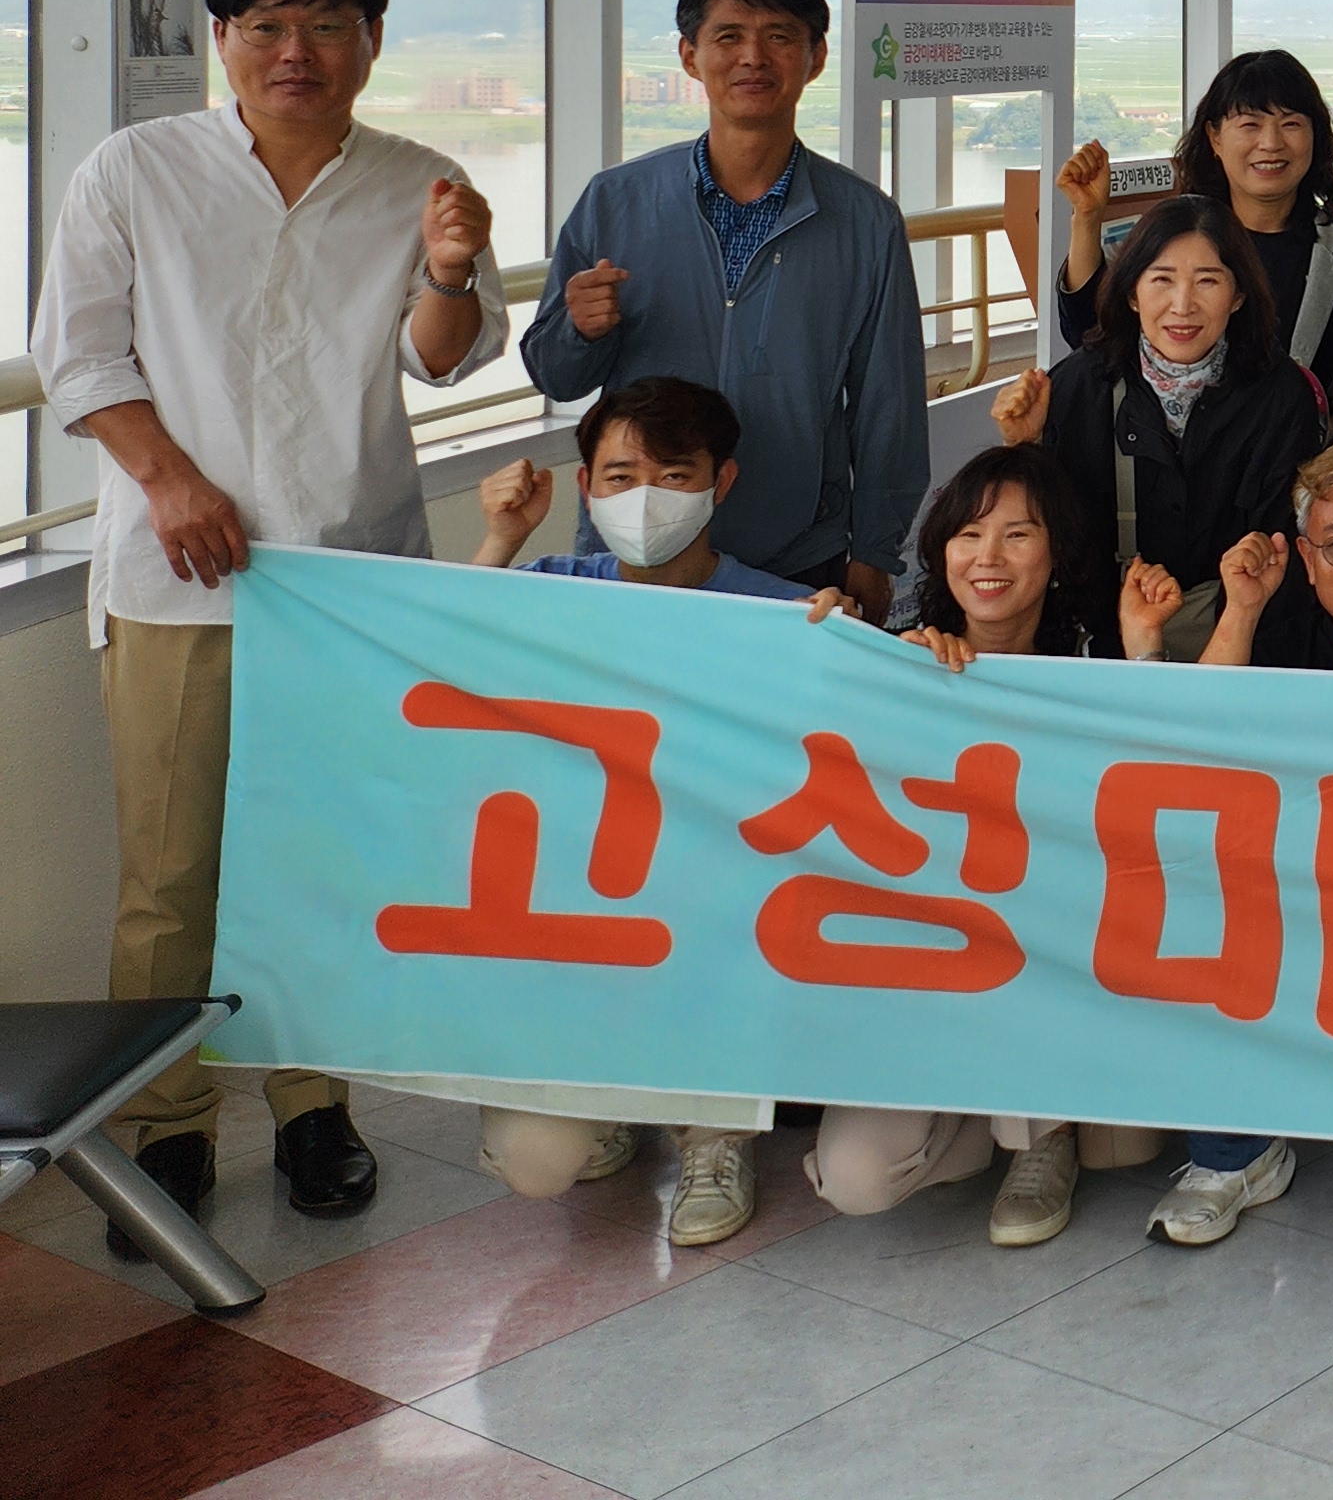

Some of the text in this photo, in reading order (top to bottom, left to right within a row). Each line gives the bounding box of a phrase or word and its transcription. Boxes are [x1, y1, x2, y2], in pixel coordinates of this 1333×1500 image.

[1008, 21, 1026, 37] 교육을
[904, 43, 975, 64] 금강미래체험관으로
[1111, 164, 1172, 192] 금강미래체험관
